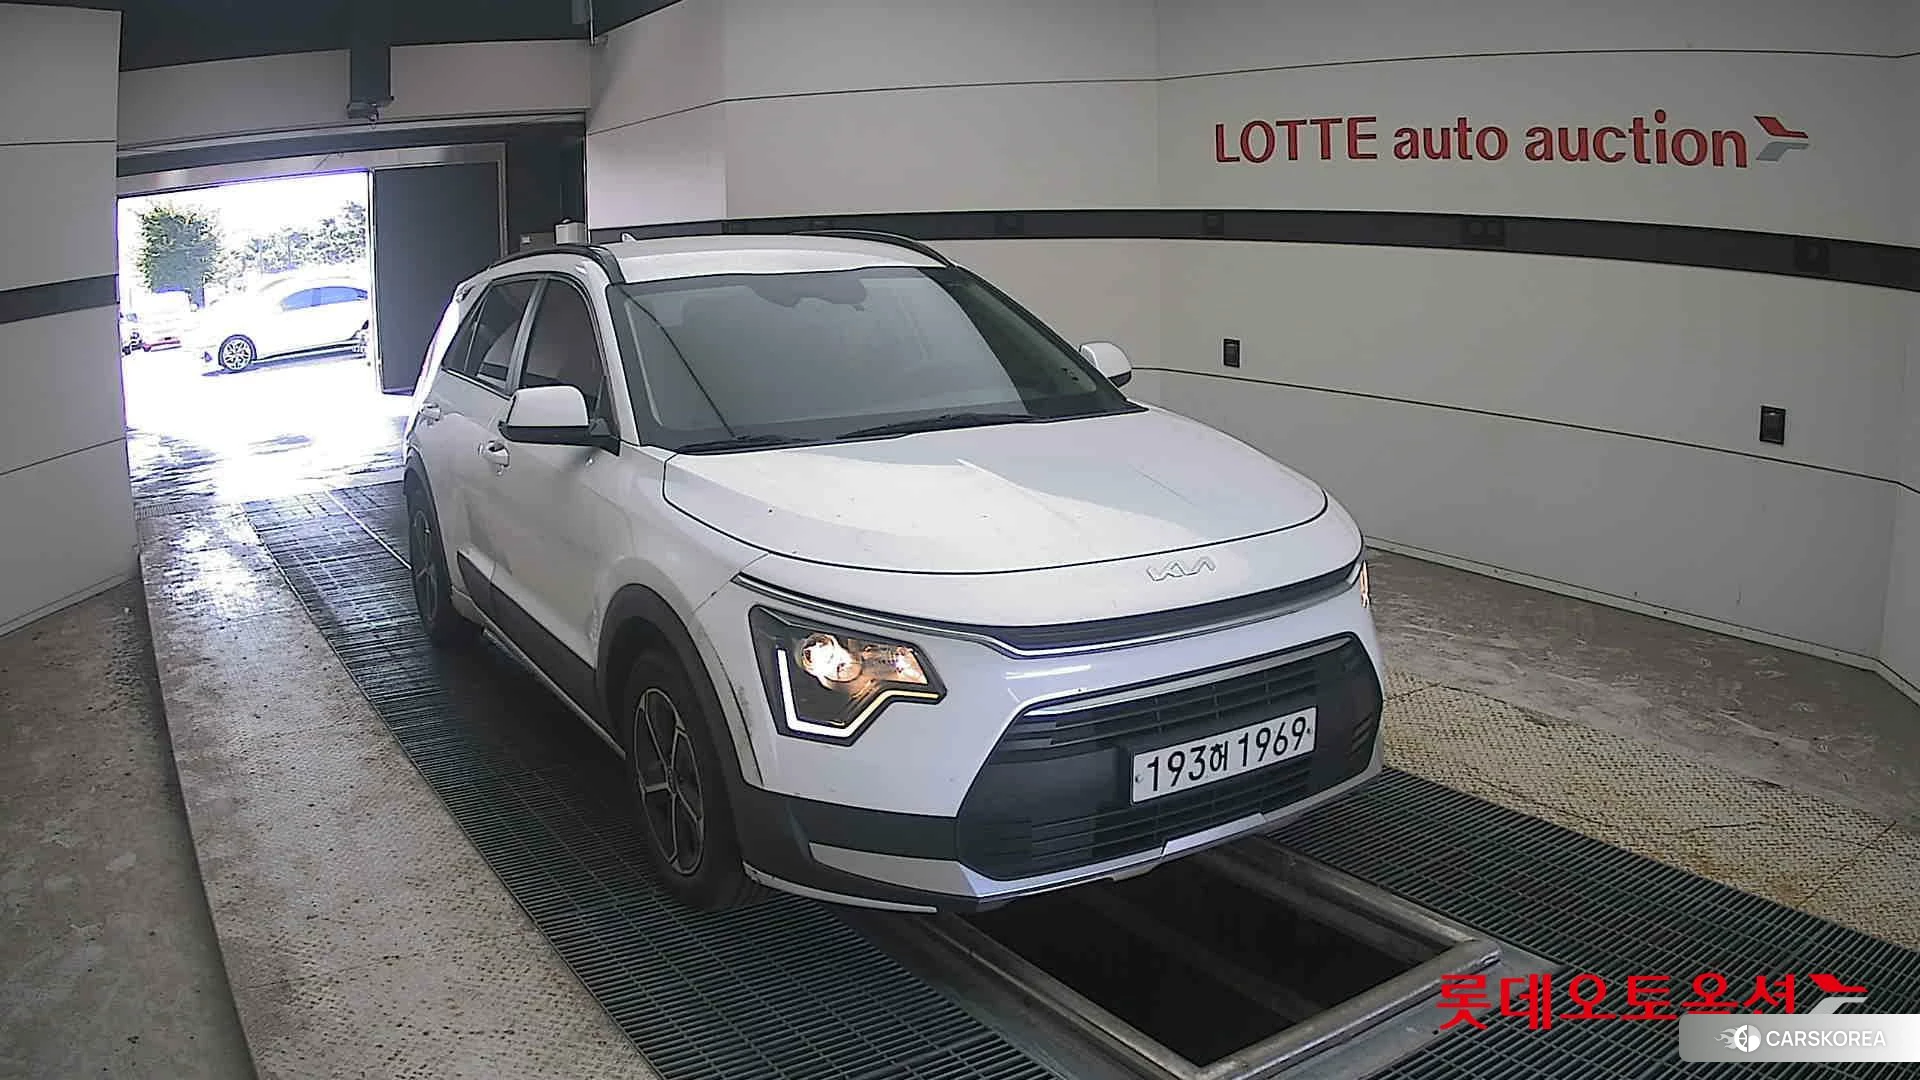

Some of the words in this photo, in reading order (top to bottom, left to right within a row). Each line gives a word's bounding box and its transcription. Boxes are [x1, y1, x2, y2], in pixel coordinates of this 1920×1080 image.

[1215, 116, 1378, 164] LOTTE
[1393, 116, 1509, 161] auto
[1525, 109, 1748, 168] auction
[1145, 556, 1217, 582] KIA
[1238, 716, 1307, 768] 1969
